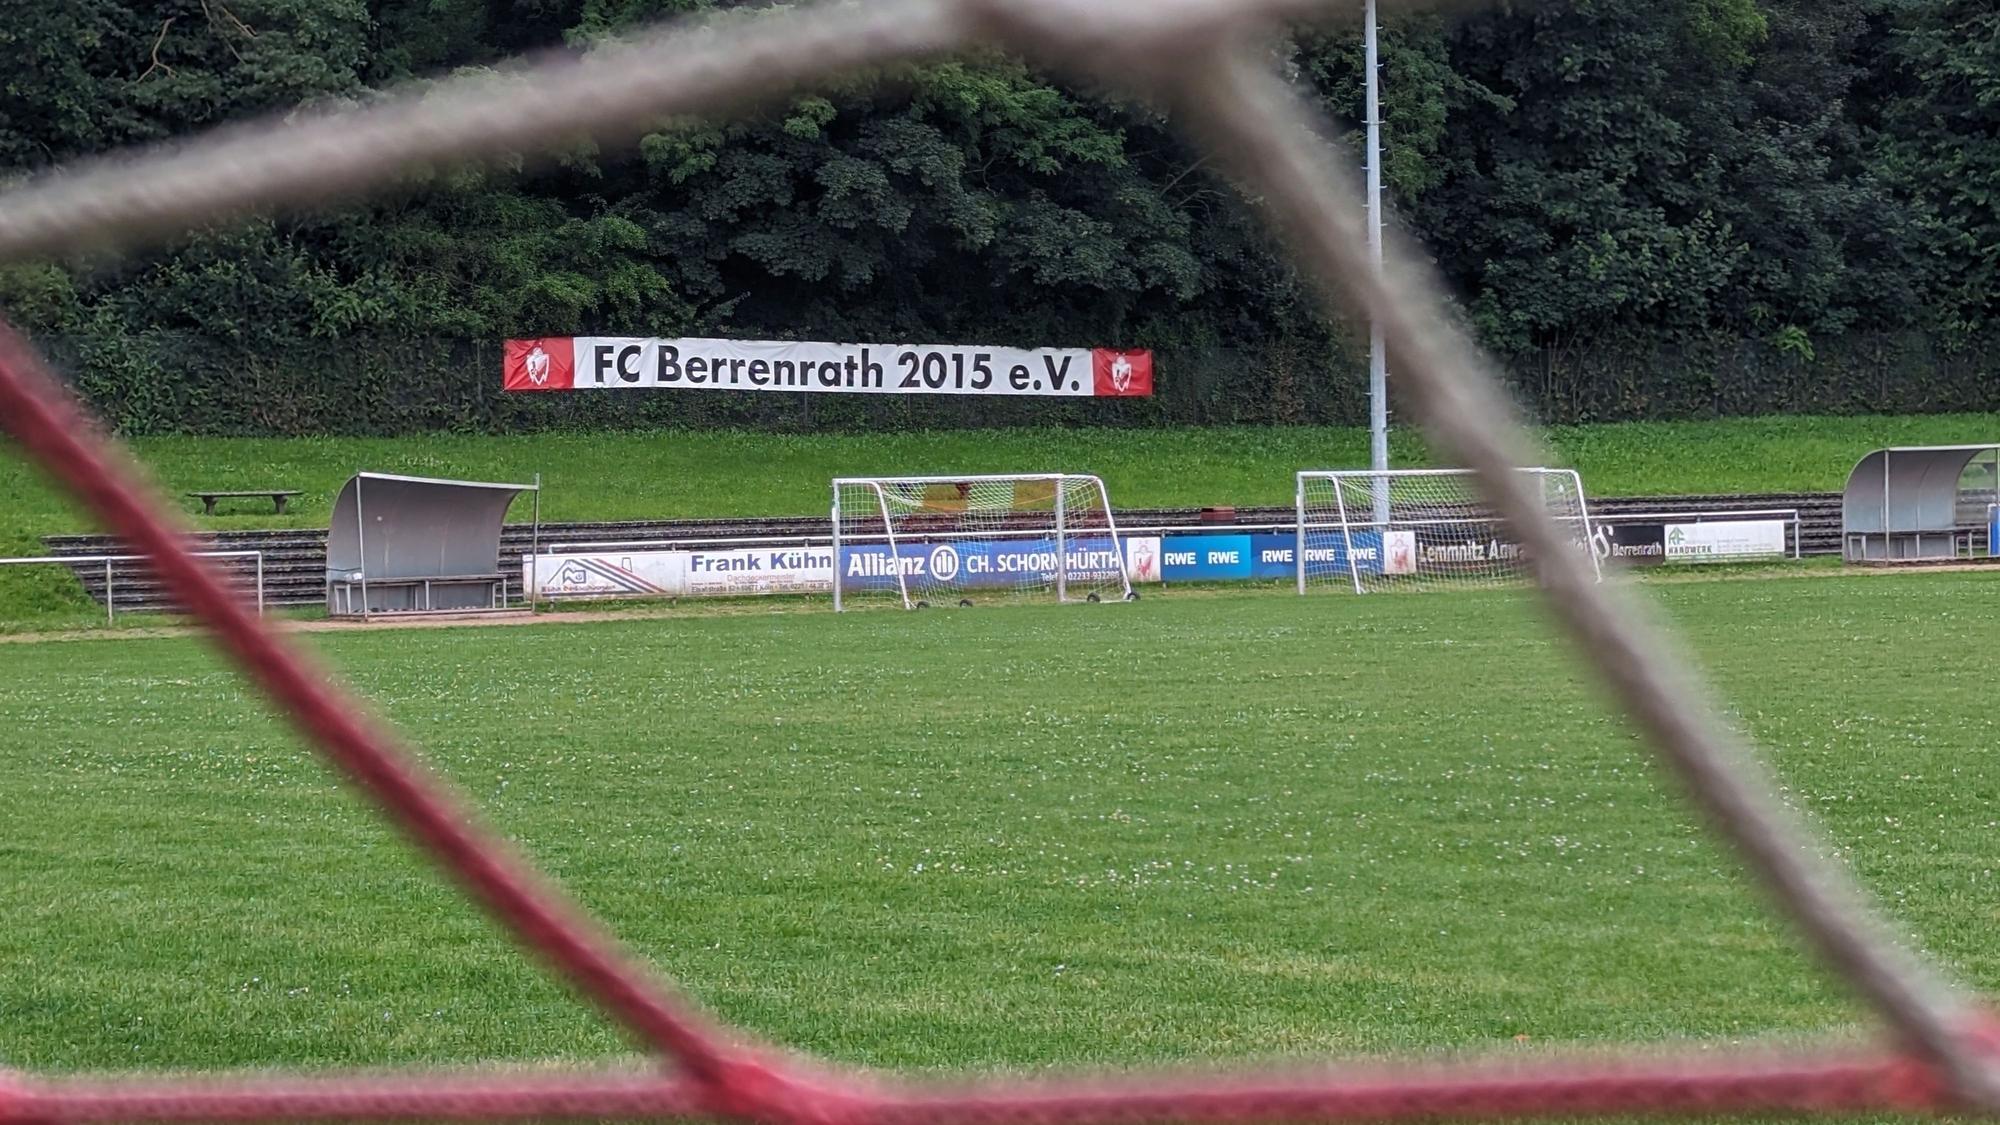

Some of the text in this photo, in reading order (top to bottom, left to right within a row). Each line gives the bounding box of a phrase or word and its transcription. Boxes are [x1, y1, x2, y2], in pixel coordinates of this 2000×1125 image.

[594, 345, 1080, 391] FC Berrenrath 2015 e.V.
[1262, 548, 1377, 562] RWE RWE RWE
[1612, 542, 1662, 556] Berrenrath
[1669, 545, 1712, 554] HANDWERK
[691, 552, 832, 572] Frank Kühn
[847, 547, 1119, 577] Allianz CH. SCHORN HÜRTH
[1165, 551, 1239, 565] RWE RWE
